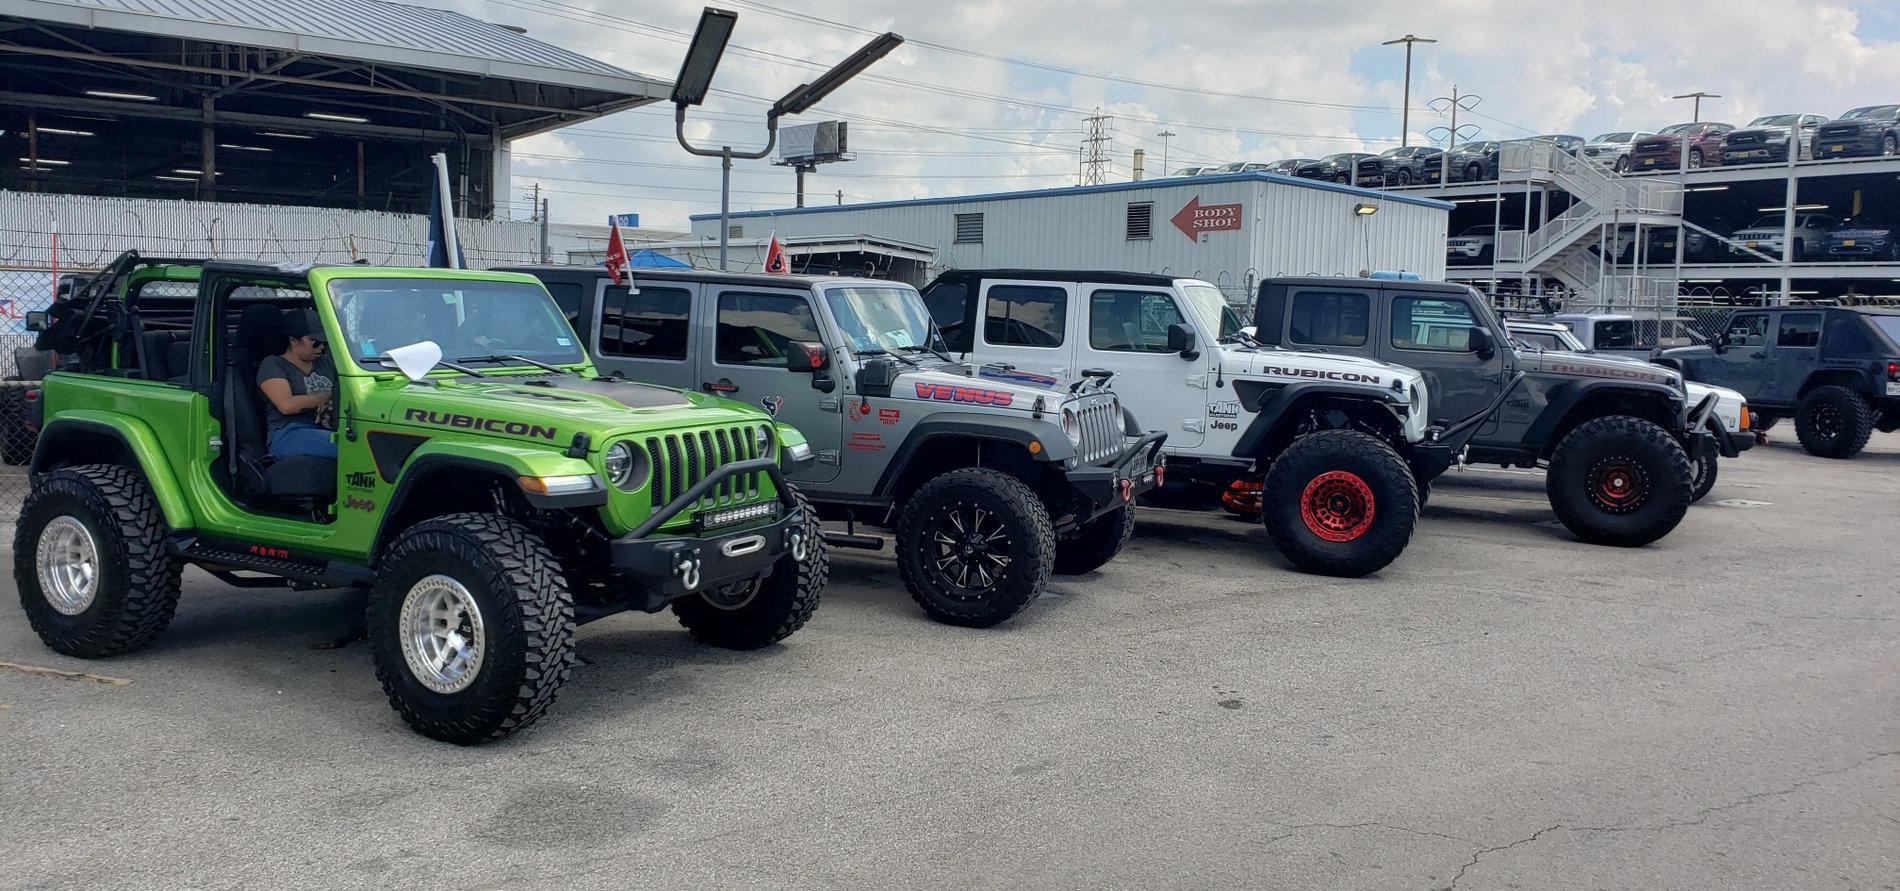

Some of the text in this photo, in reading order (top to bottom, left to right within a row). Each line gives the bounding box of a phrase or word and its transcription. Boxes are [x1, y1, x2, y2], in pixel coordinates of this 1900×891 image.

[1193, 207, 1236, 218] BODY
[1193, 218, 1237, 228] SHOP
[1263, 366, 1380, 384] RUBICON
[1551, 364, 1656, 380] RUBICON
[915, 382, 1014, 406] VENUS
[1206, 400, 1240, 415] TANK
[404, 407, 558, 440] RUBICON
[1210, 420, 1238, 431] Jeep
[345, 471, 376, 488] TANK
